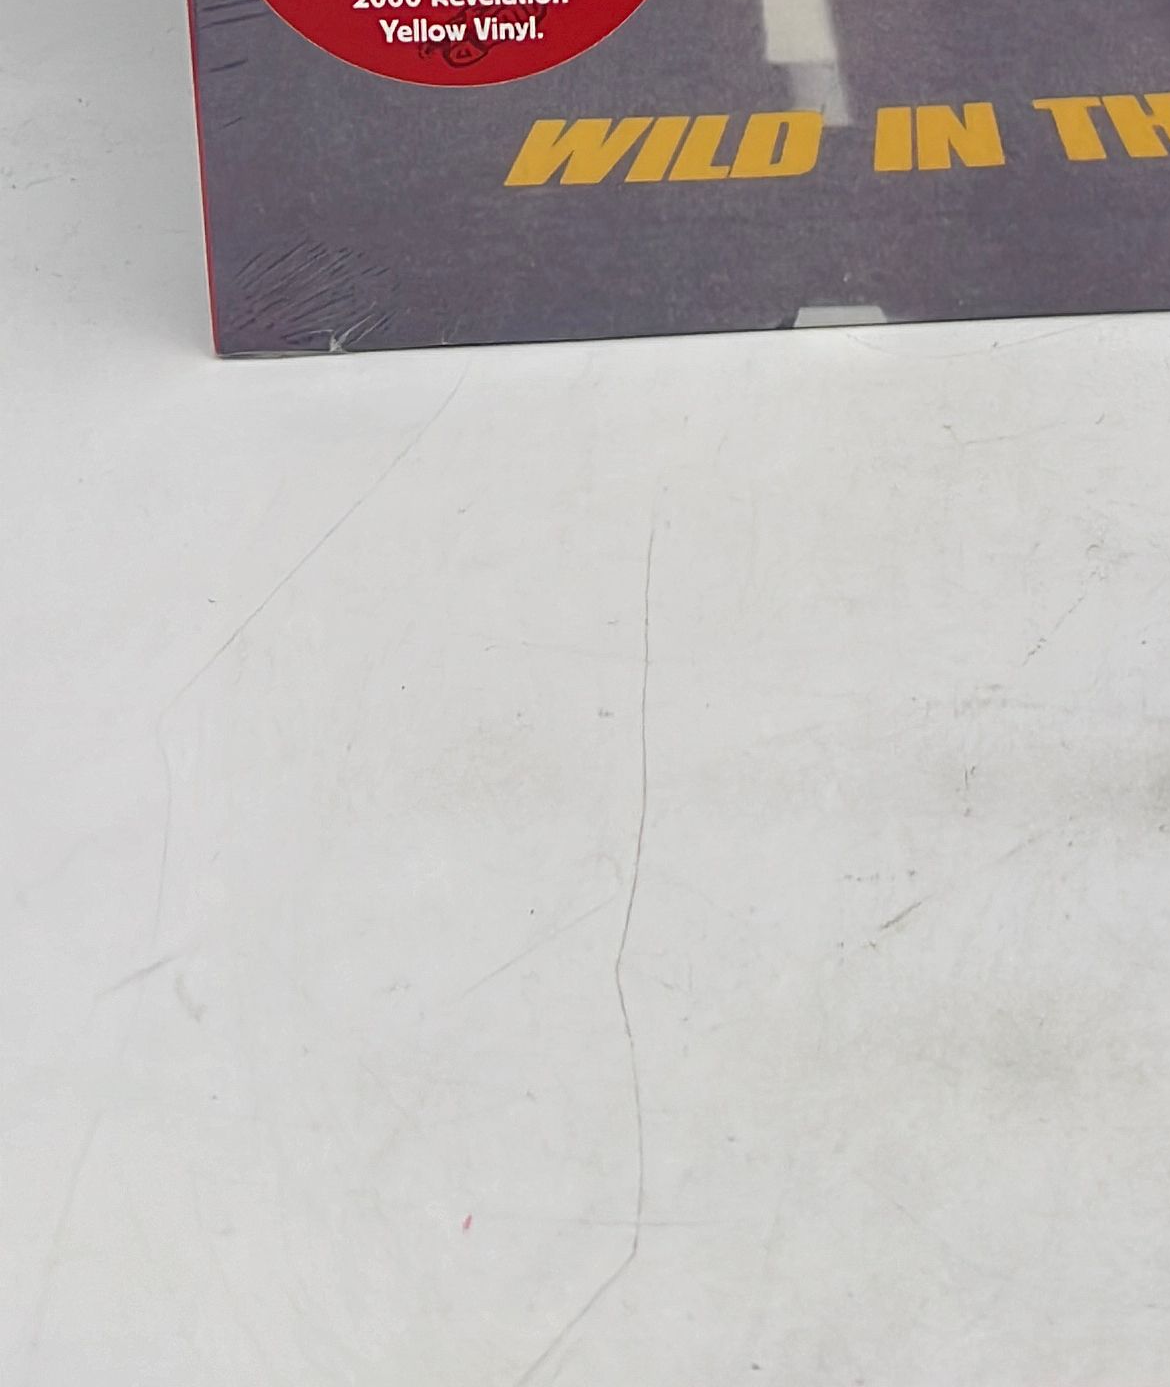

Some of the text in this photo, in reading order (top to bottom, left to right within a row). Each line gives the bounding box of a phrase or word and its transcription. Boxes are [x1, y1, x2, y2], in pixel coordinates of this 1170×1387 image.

[379, 15, 544, 43] Yellow Vinyl.
[504, 109, 826, 188] WILD
[872, 101, 1005, 173] IN
